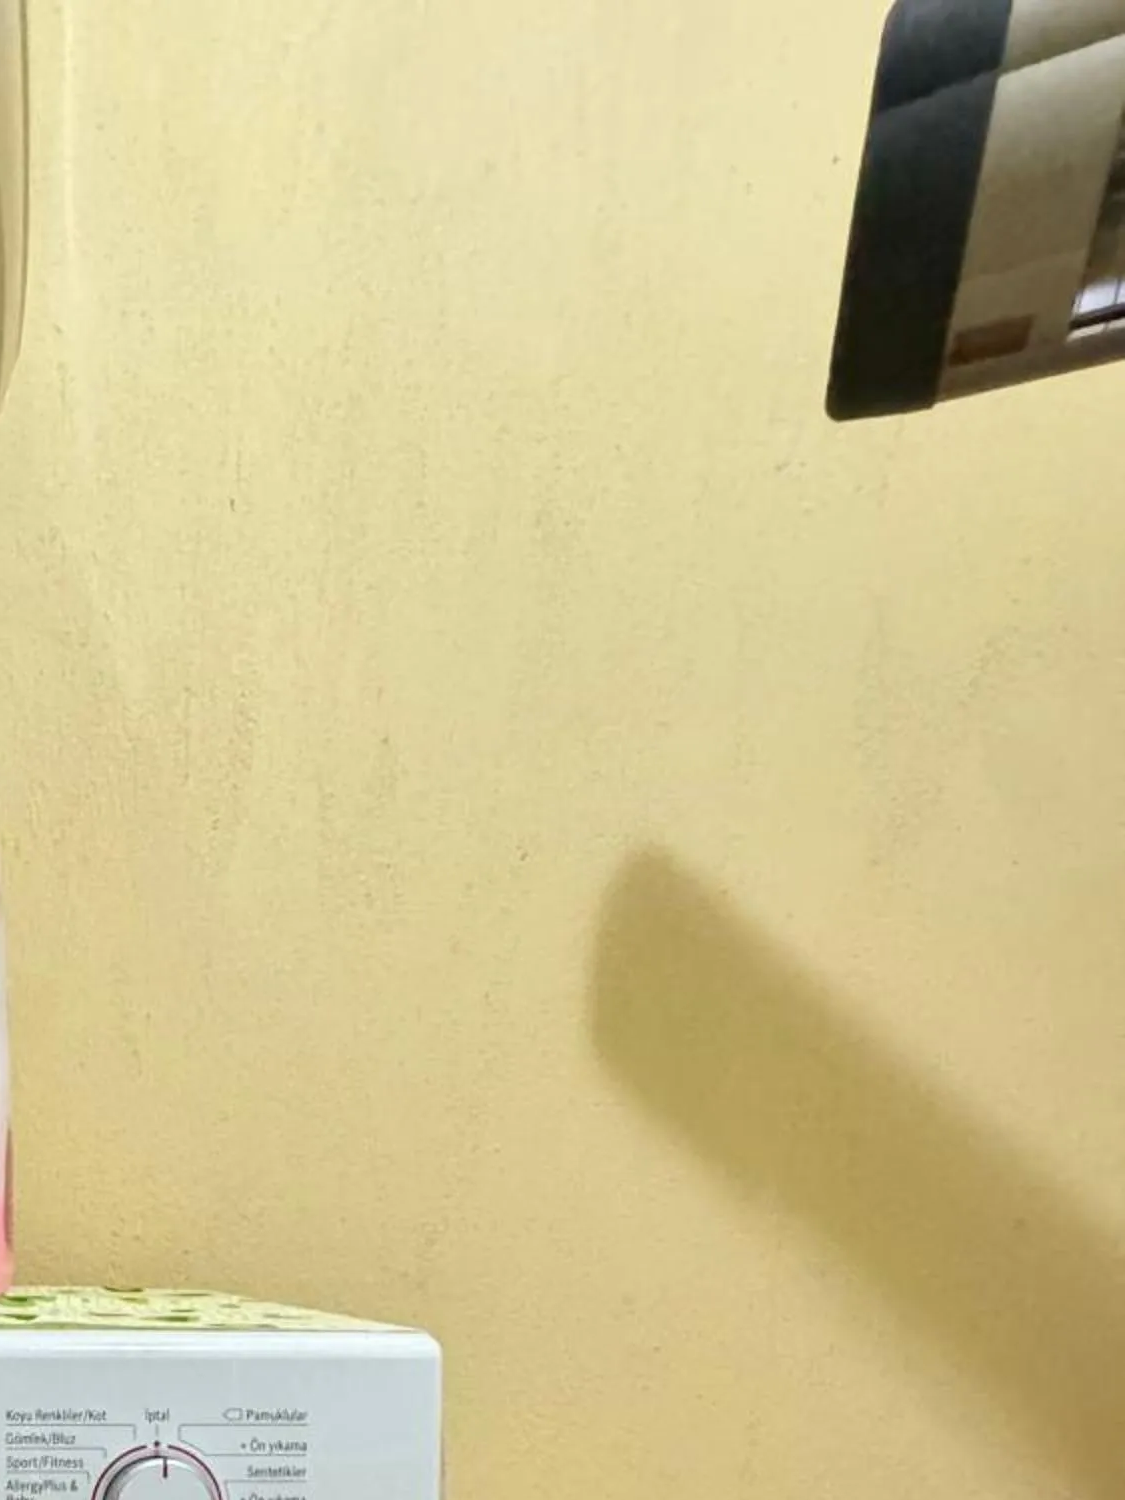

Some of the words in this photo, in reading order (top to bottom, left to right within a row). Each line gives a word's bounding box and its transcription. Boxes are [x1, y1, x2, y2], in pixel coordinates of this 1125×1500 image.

[5, 1410, 32, 1422] Koyu
[246, 1409, 308, 1421] Pamuklular
[6, 1455, 84, 1470] Sport/Fitness
[247, 1465, 307, 1477] Sentetikler
[6, 1480, 67, 1494] AllergyPlus
